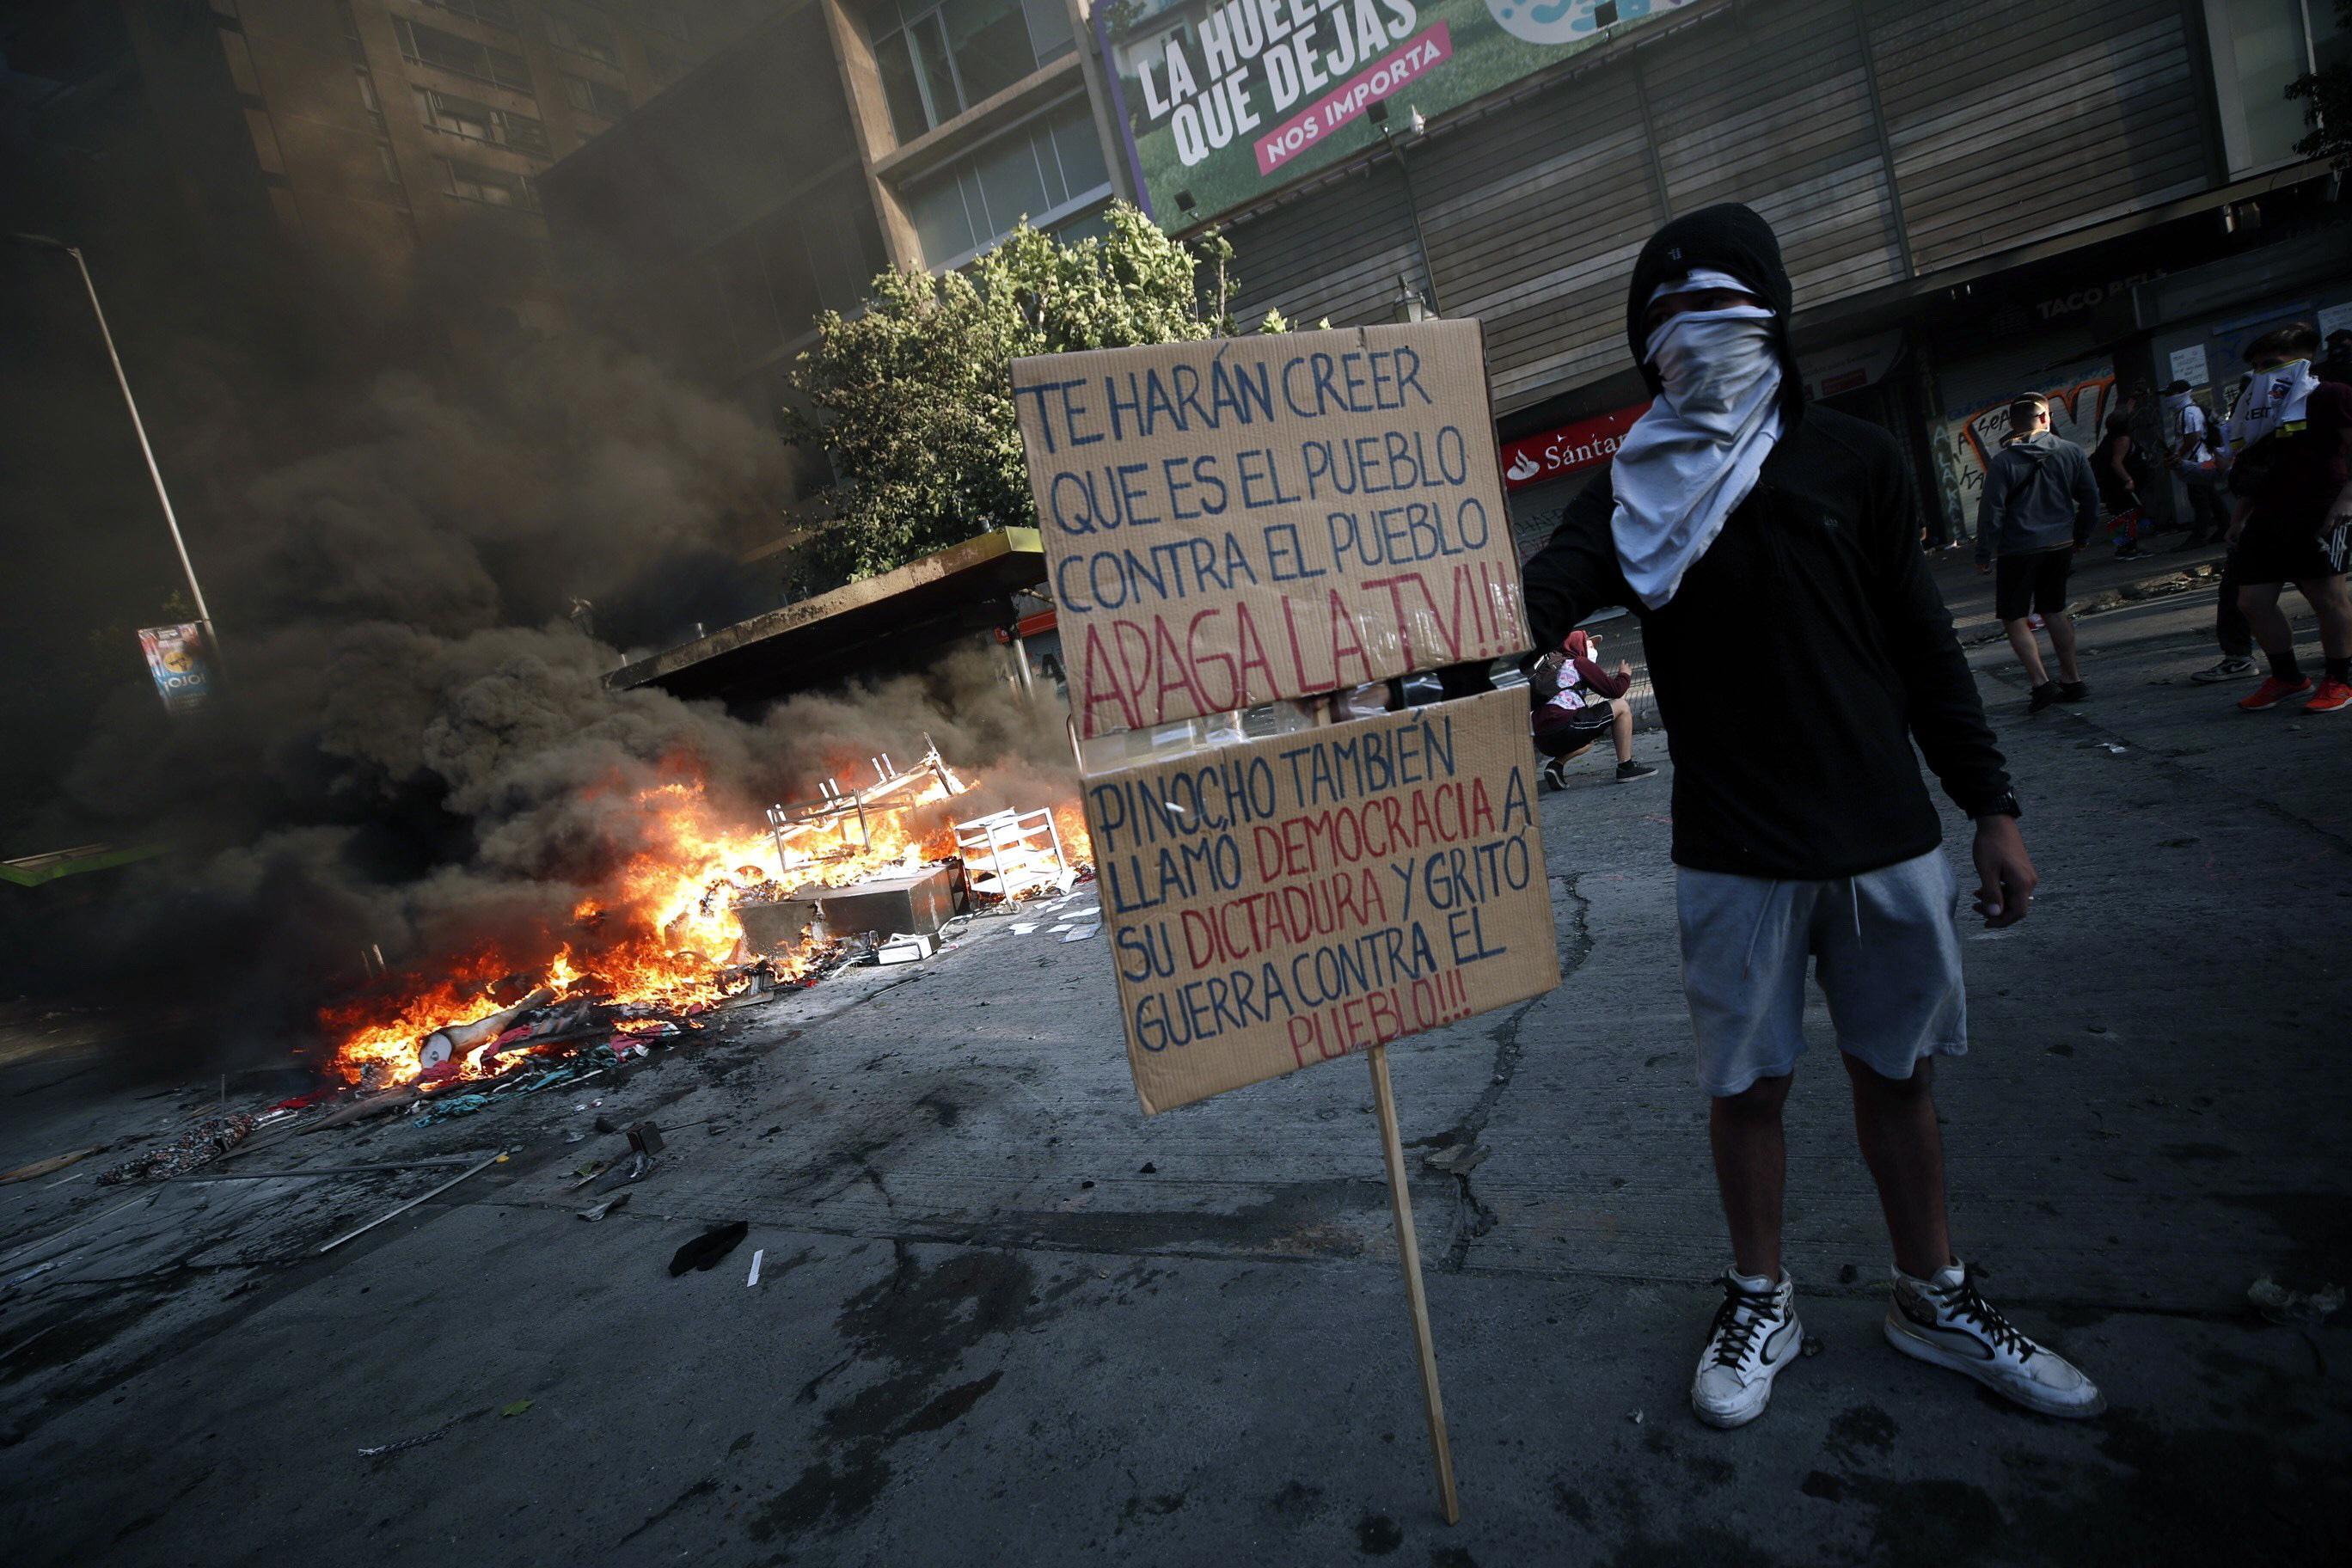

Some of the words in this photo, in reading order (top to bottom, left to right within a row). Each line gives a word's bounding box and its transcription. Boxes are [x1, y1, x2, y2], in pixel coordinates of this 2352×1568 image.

[1137, 40, 1197, 120] LA
[1171, 65, 1261, 166] QUE
[1263, 0, 1417, 113] DEJAS
[1265, 117, 1319, 164] NOS
[1326, 40, 1442, 128] IMPORTA
[2036, 287, 2104, 319] TACO
[1014, 379, 1104, 453] TE
[1106, 342, 1274, 440] HARÁN
[1283, 346, 1432, 418] CREER
[1050, 463, 1161, 536] QUE
[1163, 455, 1228, 521] ES
[1238, 449, 1301, 509] EL
[1302, 426, 1467, 499] PUEBLO
[1057, 532, 1259, 613] CONTRA
[1265, 523, 1327, 582] EL
[1329, 497, 1488, 573] PUEBLO
[1084, 601, 1283, 738] APAGA
[1282, 588, 1374, 693] LA
[1362, 560, 1521, 673] TV!!!
[1090, 756, 1275, 852] PINOCHO
[1280, 709, 1455, 808] TAMBIÉN
[1107, 825, 1241, 915] LLAMÓ
[1253, 777, 1495, 883] DEMOCRACIA
[1503, 766, 1532, 832] A
[1118, 921, 1175, 983] SU
[1181, 867, 1387, 970] DICTADURA
[1391, 858, 1415, 922] Y
[1424, 824, 1531, 910] GRITÓ
[1135, 962, 1295, 1053] GUERRA
[1292, 921, 1436, 1008] CONTRA
[1448, 906, 1507, 966] EL
